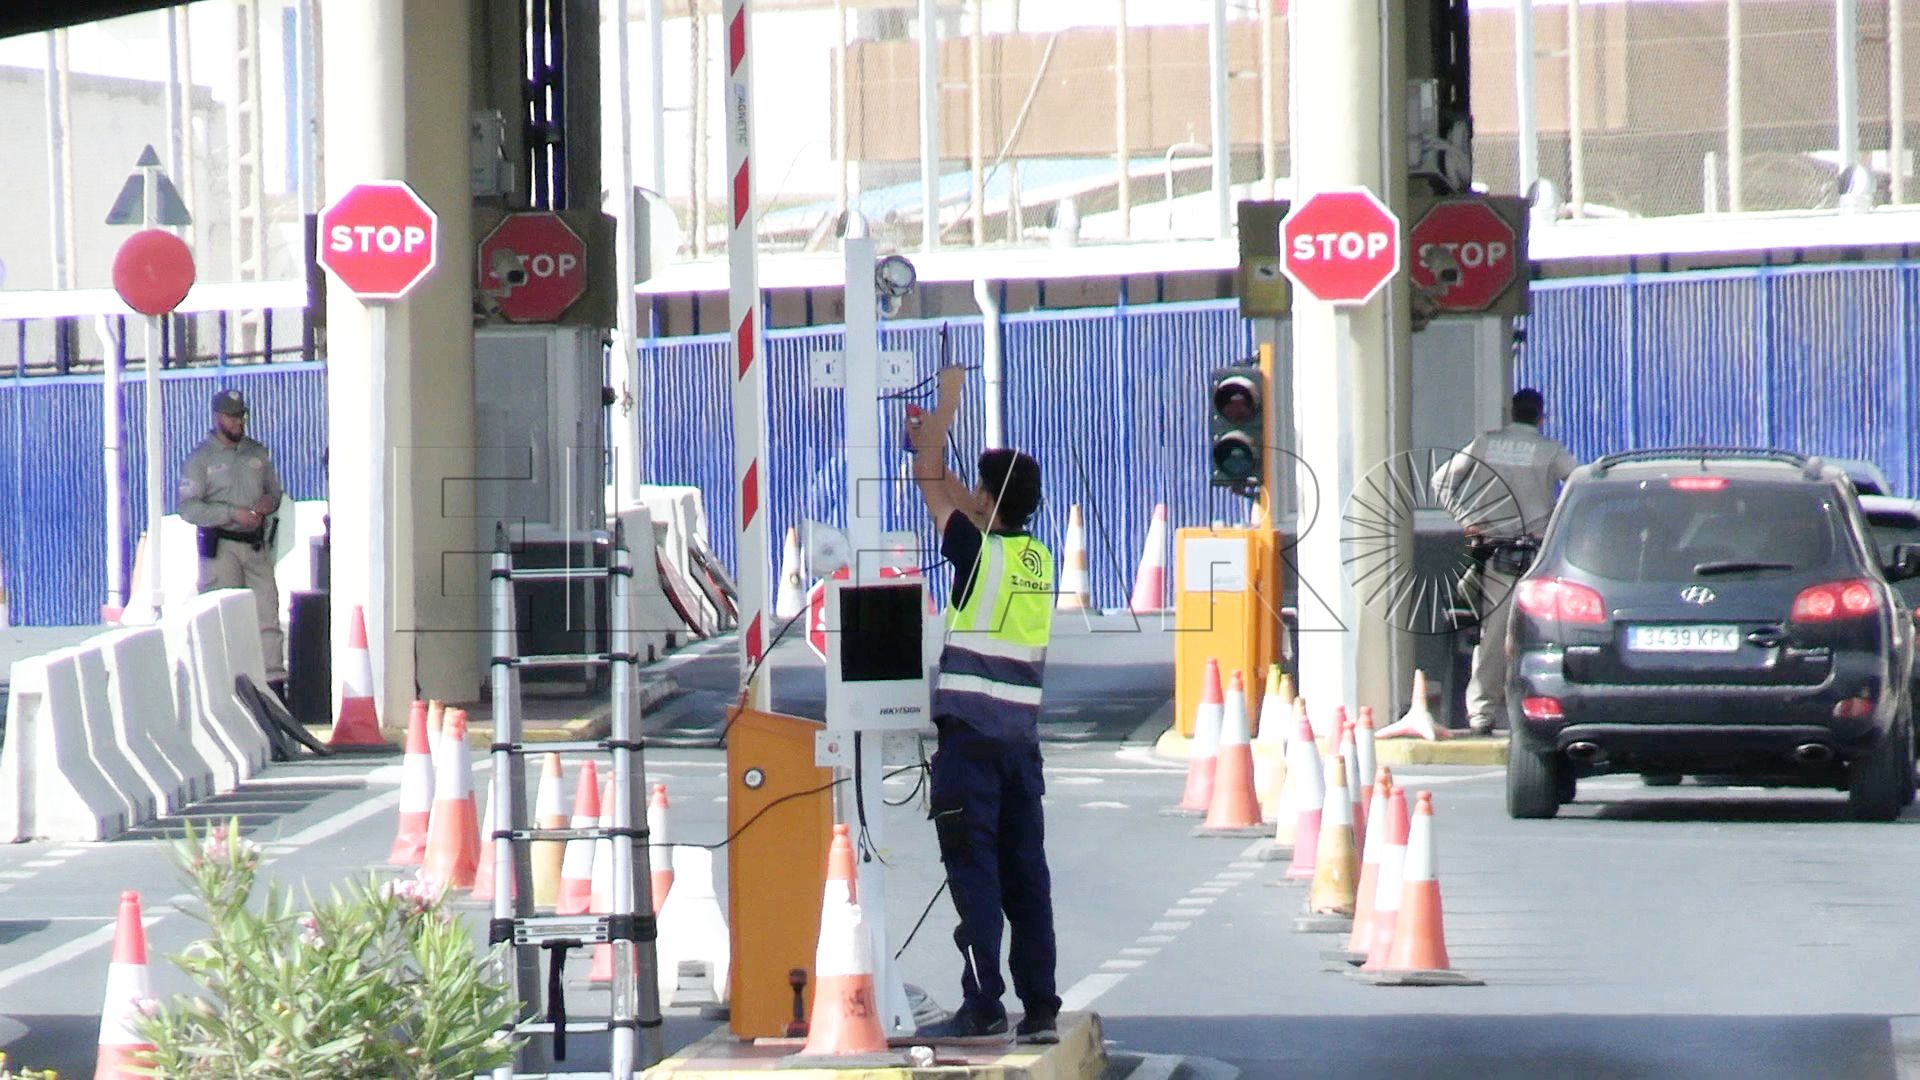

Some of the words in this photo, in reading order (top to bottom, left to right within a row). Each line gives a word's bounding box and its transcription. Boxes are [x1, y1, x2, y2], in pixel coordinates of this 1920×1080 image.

[330, 225, 425, 253] STOP
[1292, 231, 1389, 260] STOP
[1645, 628, 1691, 647] 3439
[1697, 627, 1734, 647] KPK
